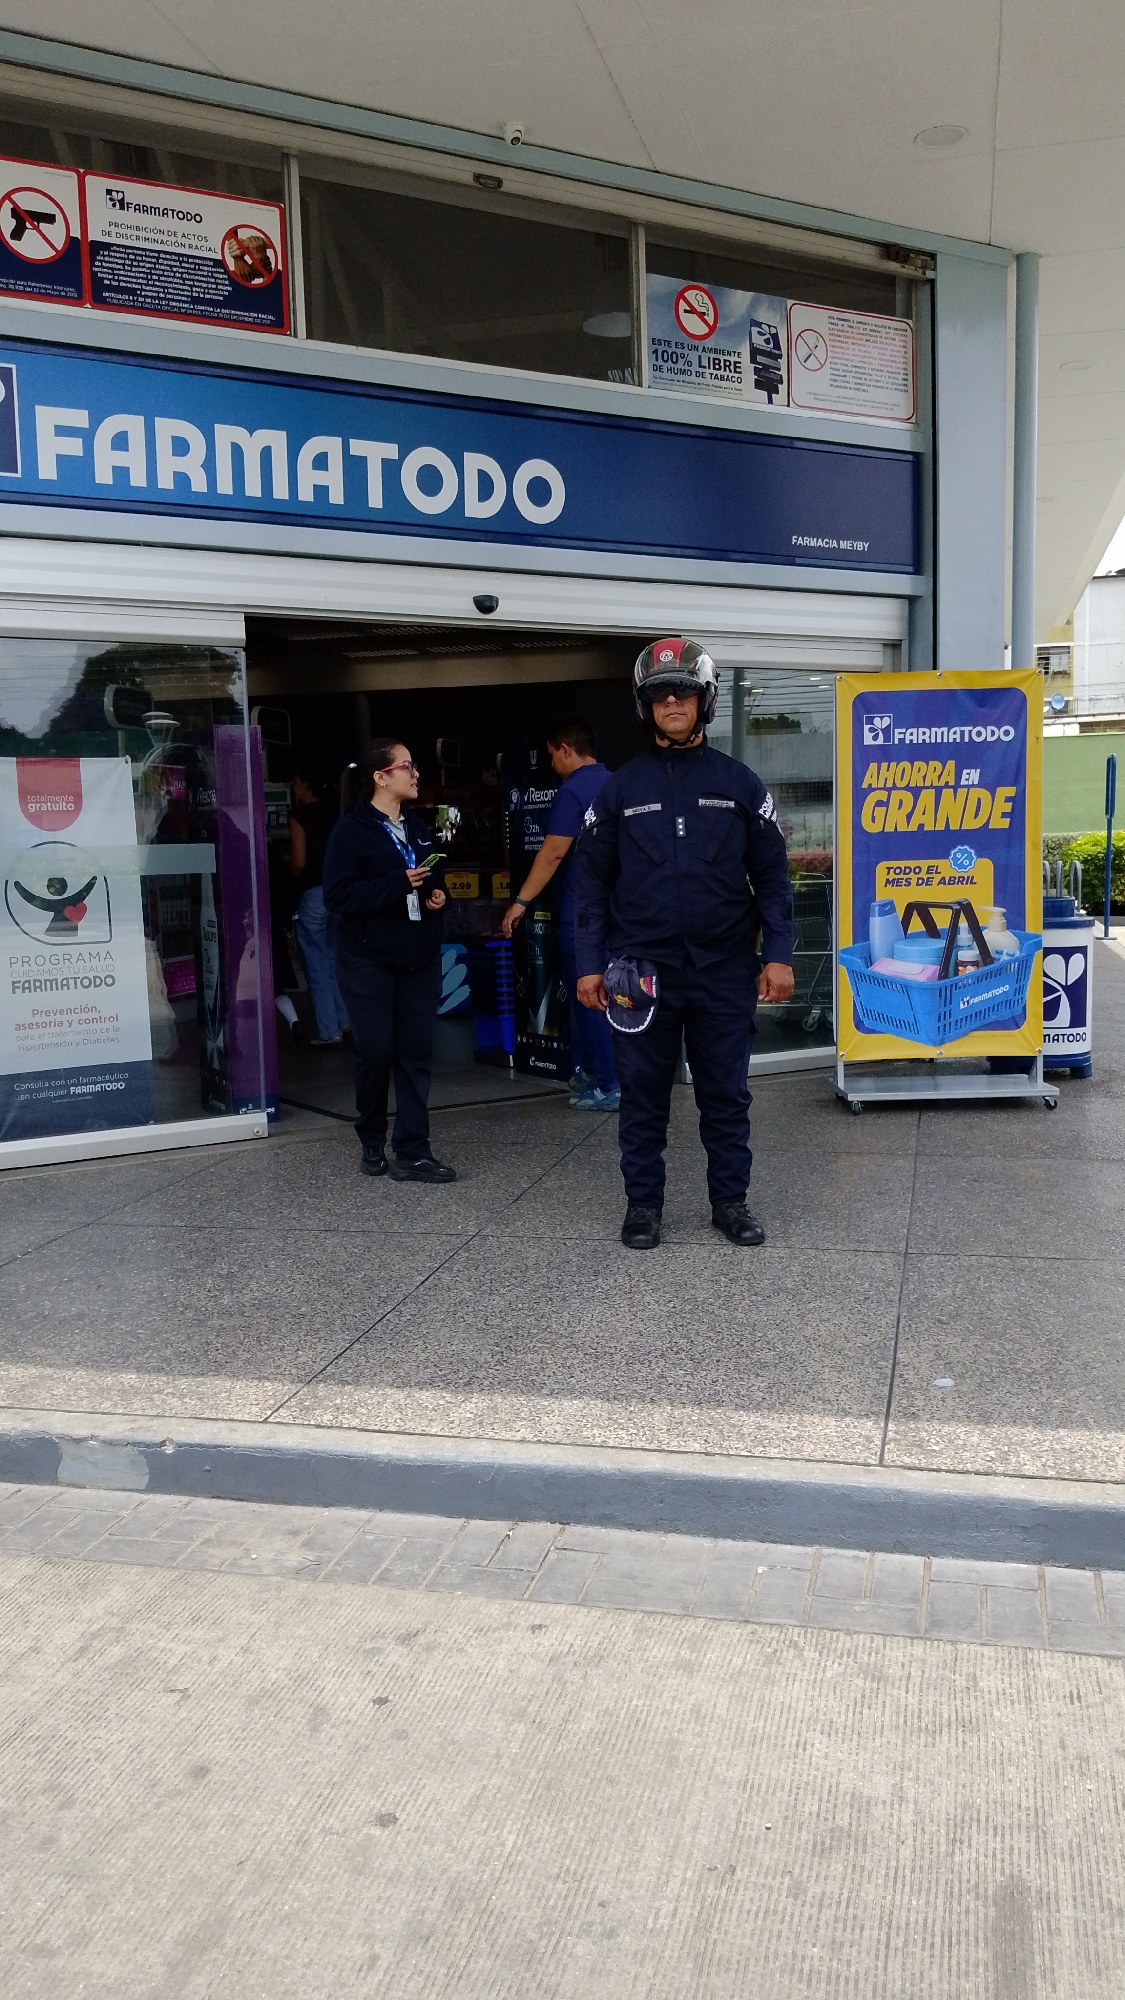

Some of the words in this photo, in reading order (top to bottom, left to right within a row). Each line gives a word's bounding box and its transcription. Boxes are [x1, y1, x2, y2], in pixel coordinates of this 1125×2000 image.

[125, 201, 203, 224] FARMATODO
[108, 221, 164, 236] PROHIBICIÓN
[167, 230, 178, 238] DE
[181, 232, 208, 243] ACTOS
[101, 229, 112, 238] DE
[115, 231, 185, 249] DISCRIMINACIÓN
[188, 243, 217, 254] RACIAL
[651, 337, 672, 348] ESTE
[675, 341, 685, 350] ES
[687, 343, 698, 352] UN
[701, 345, 741, 359] AMBIENTE
[652, 347, 692, 367] 100%
[698, 354, 742, 375] LIBRE
[653, 363, 663, 373] DE
[666, 365, 692, 377] HUMO
[695, 370, 706, 379] DE
[709, 372, 742, 385] TABACO
[34, 404, 566, 525] FARMATODO
[791, 535, 838, 548] FARMACIA
[839, 539, 869, 551] MEYBY
[894, 725, 1015, 744] FARMATODO
[861, 760, 955, 788] AHORRA
[960, 769, 980, 785] EN
[27, 794, 74, 802] totalmente
[28, 801, 74, 812] gratuito
[861, 786, 1016, 833] GRANDE
[885, 865, 922, 875] TODO
[925, 865, 941, 874] EL
[884, 877, 912, 887] MES
[915, 876, 934, 886] DE
[936, 875, 977, 886] ABRIL
[9, 951, 114, 968] PROGRAMA
[10, 967, 64, 978] CUIDAMOS
[66, 966, 80, 975] TU
[82, 963, 115, 973] SALUD
[11, 974, 115, 994] FARMATODO
[969, 984, 1009, 1005] FARMATODO
[32, 1004, 100, 1018] Prevención,
[14, 1018, 63, 1031] asesoría
[67, 1018, 73, 1028] y
[77, 1014, 118, 1025] control
[16, 1034, 35, 1042] para
[38, 1031, 44, 1039] el
[48, 1027, 97, 1038] tratamiento
[112, 1025, 119, 1033] la
[79, 1072, 128, 1083] farmacéutico
[32, 1089, 67, 1099] cualquier
[70, 1081, 125, 1095] FARMATODO
